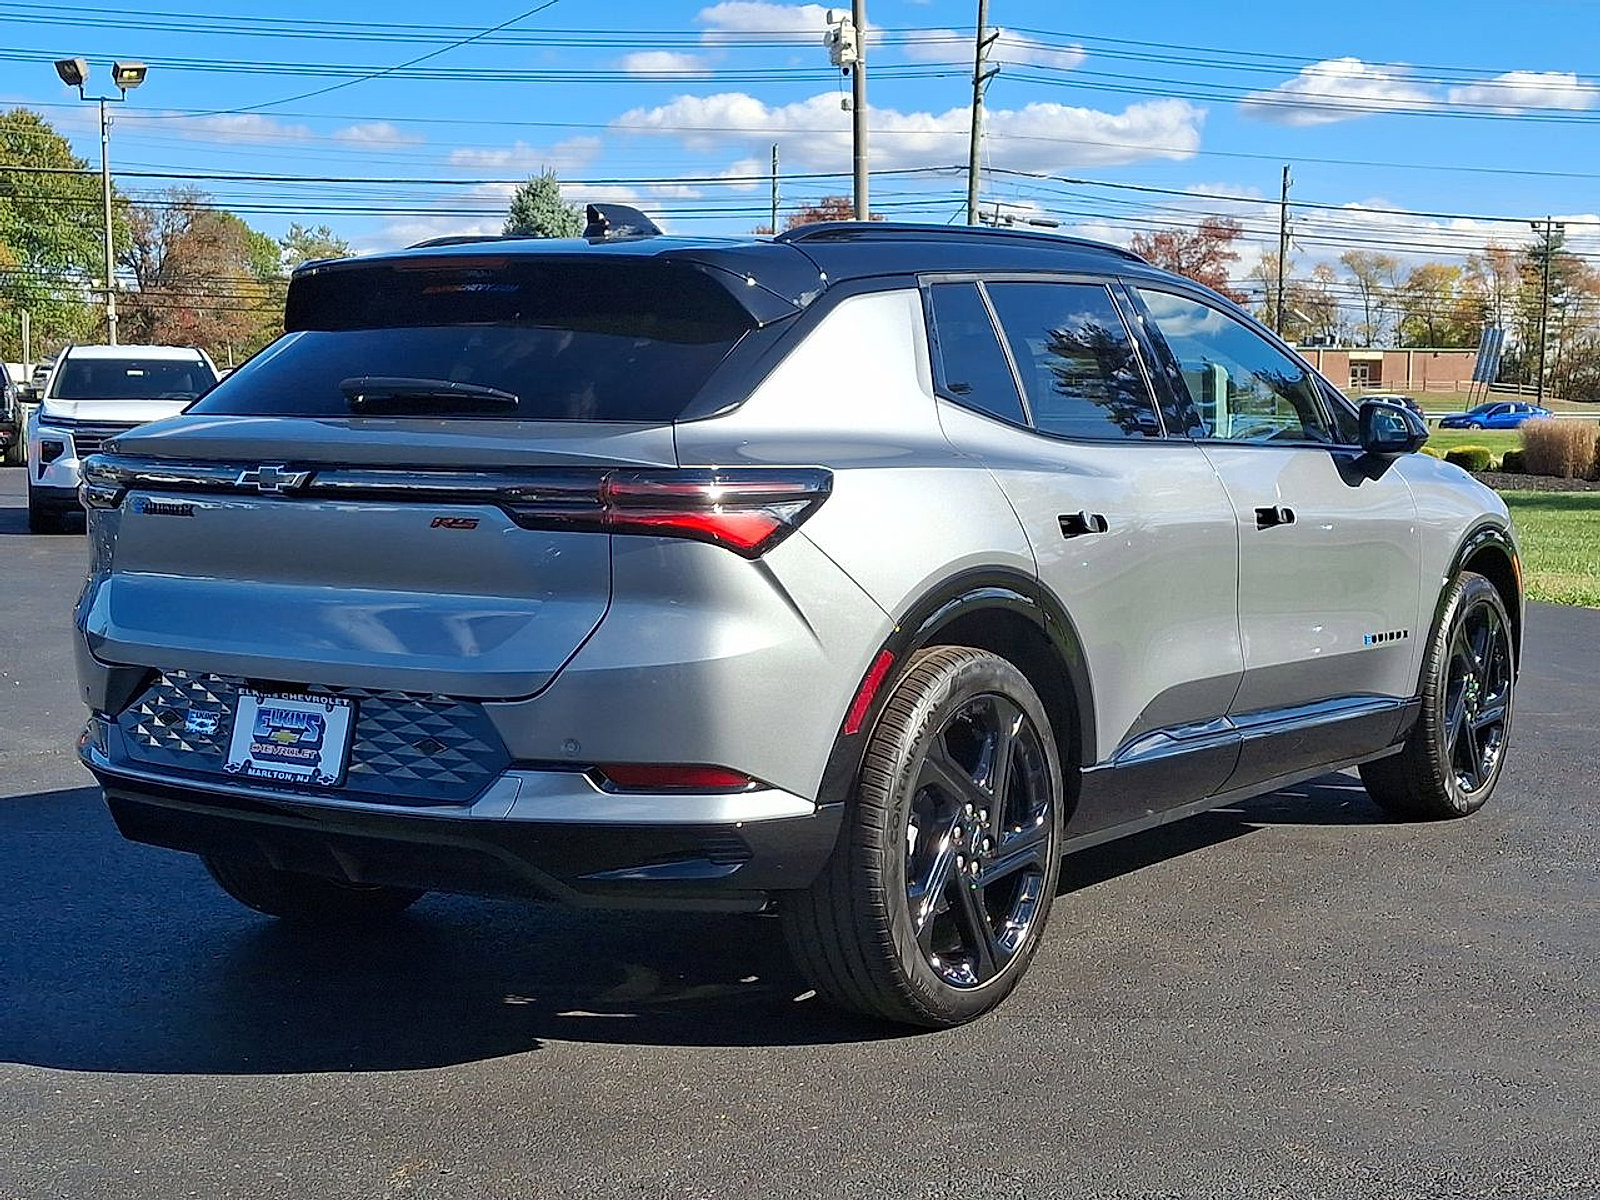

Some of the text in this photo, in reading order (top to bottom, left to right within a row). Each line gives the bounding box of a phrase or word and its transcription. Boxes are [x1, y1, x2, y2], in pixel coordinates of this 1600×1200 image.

[431, 516, 480, 530] RS
[281, 692, 350, 706] CHEVROLET
[253, 707, 321, 742] ELKINS
[251, 743, 318, 759] CHEVROLET
[248, 768, 294, 782] MARLTON,
[890, 702, 938, 846] CONTINENTAL
